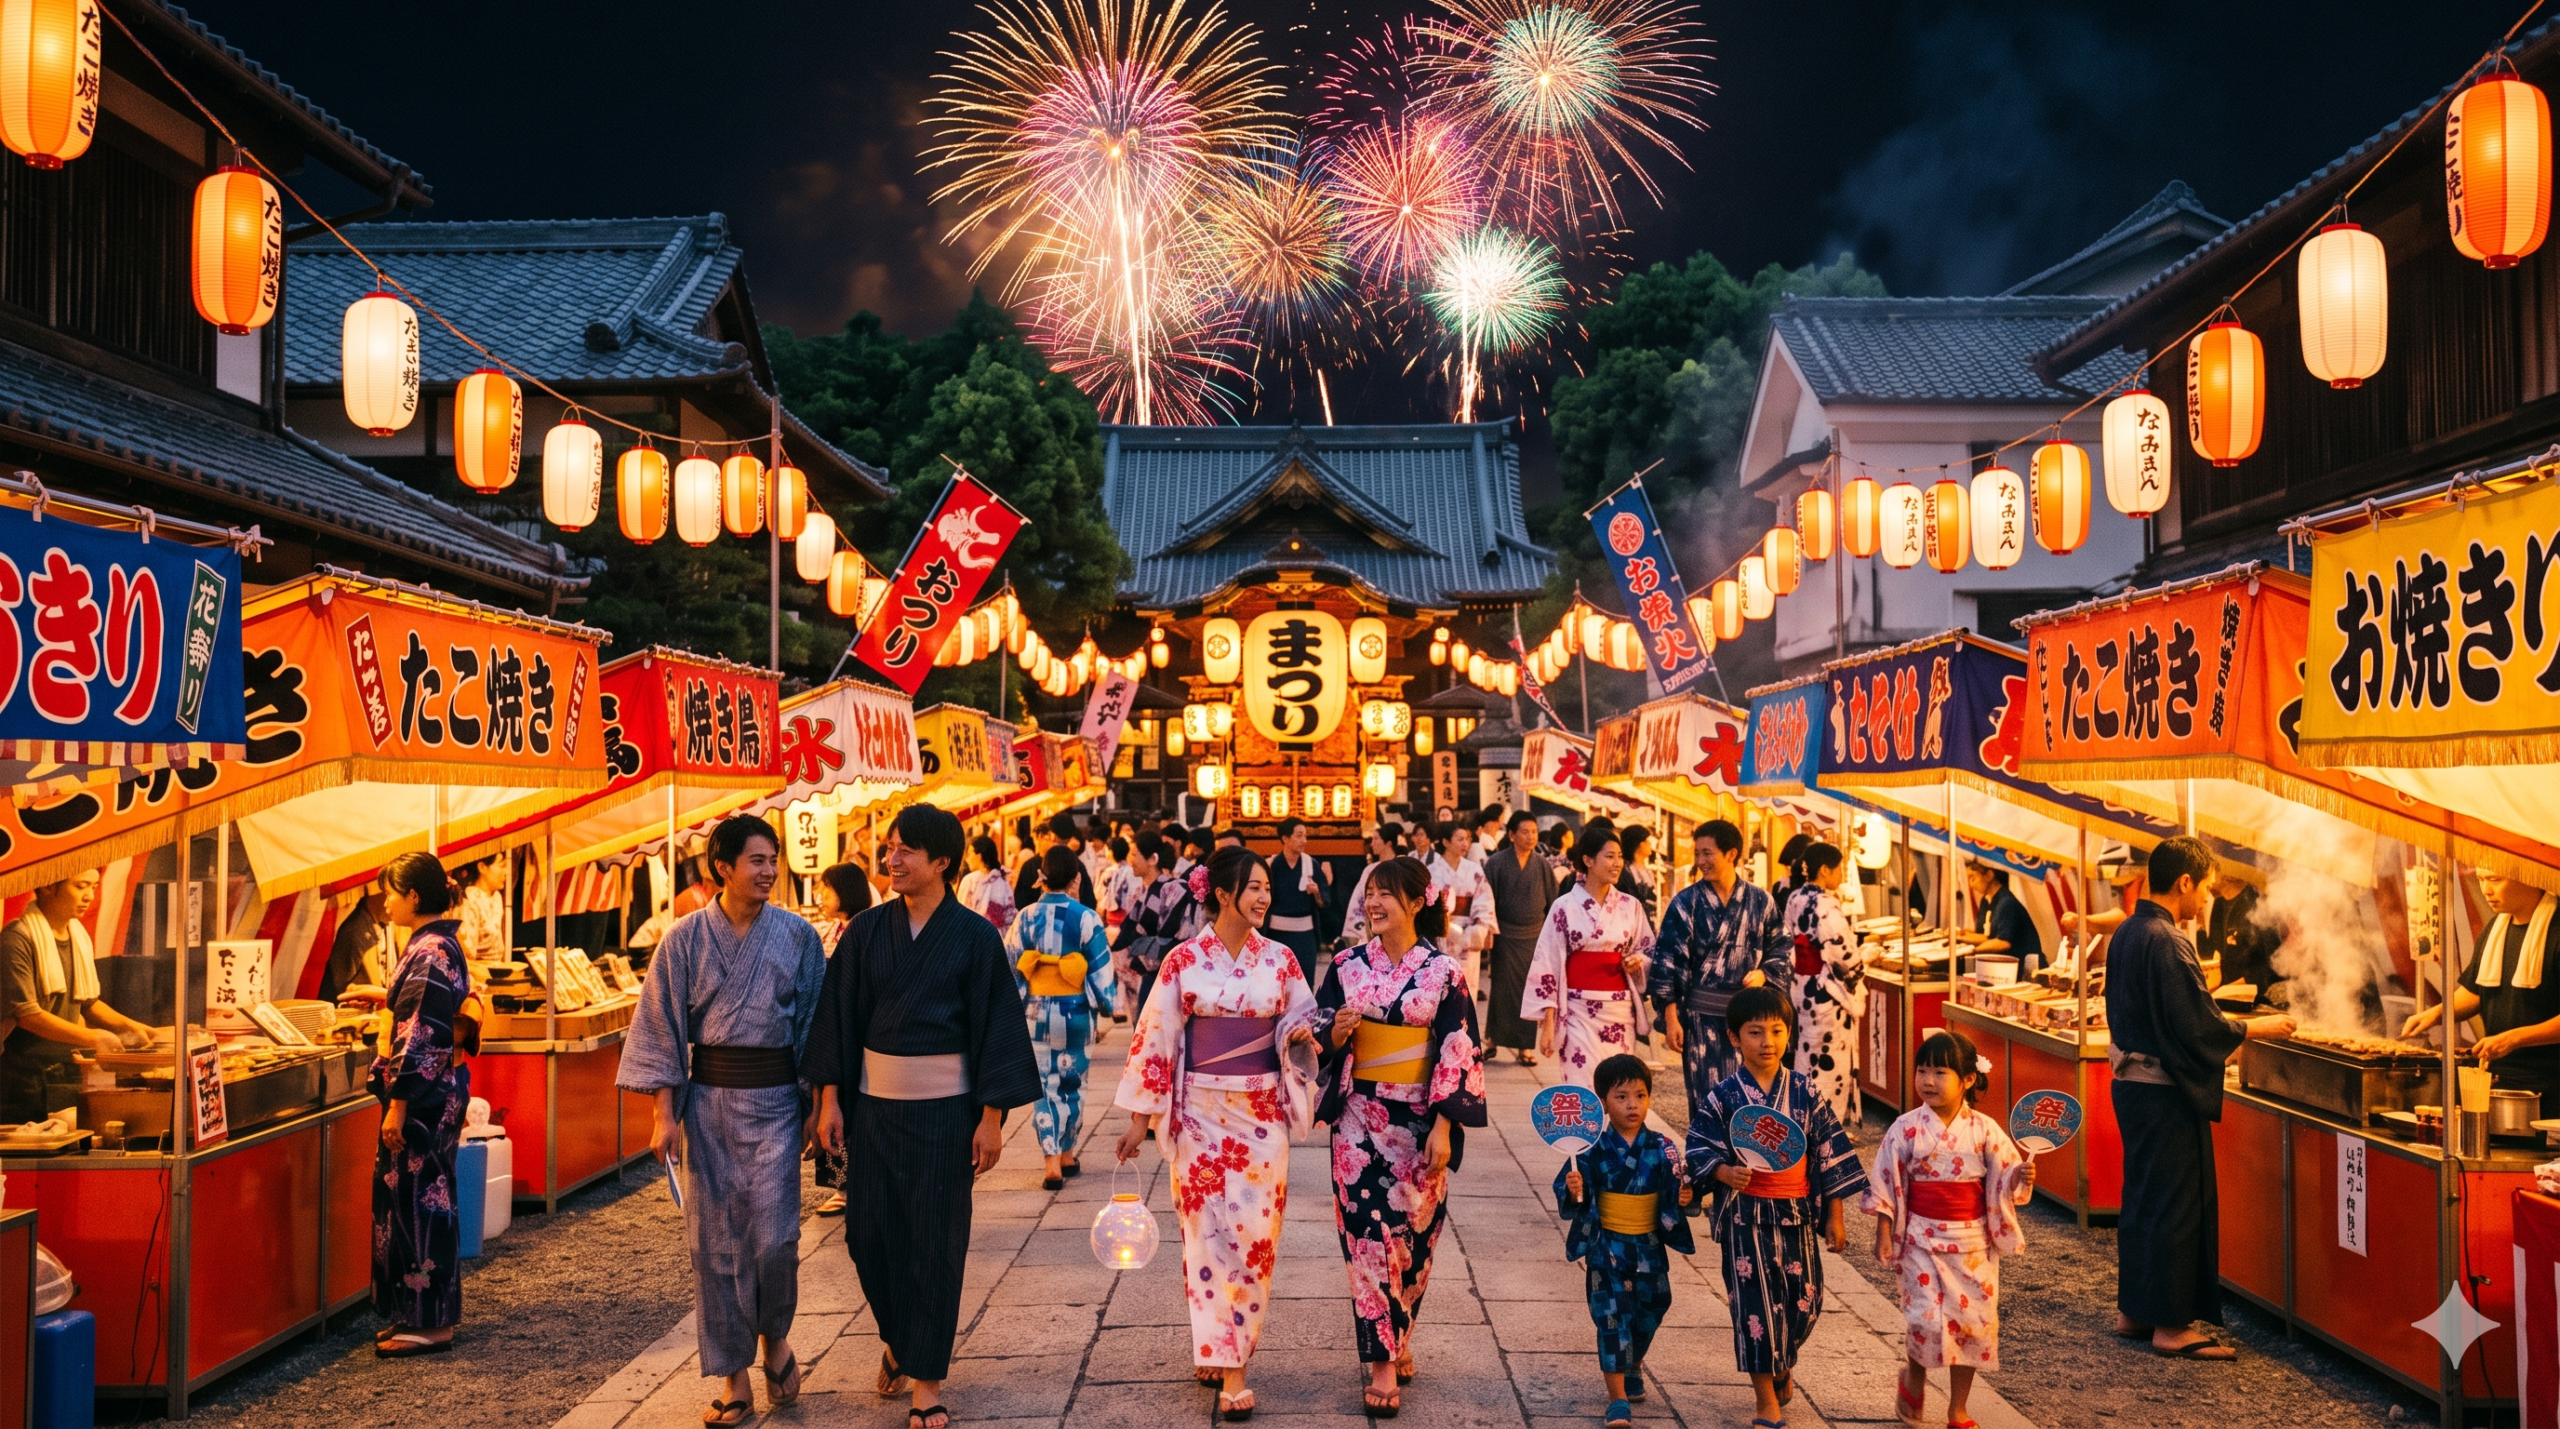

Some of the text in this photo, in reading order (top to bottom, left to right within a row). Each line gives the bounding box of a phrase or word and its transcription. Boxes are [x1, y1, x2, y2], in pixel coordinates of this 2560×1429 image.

[2137, 408, 2160, 491] なみまん
[883, 556, 960, 668] おつり
[400, 629, 556, 757] たこ焼き
[684, 677, 761, 768] 焼き鳥
[1267, 620, 1323, 737] まつり
[2060, 618, 2202, 743] たこ焼き
[1550, 1092, 1584, 1127] 祭
[1749, 1114, 1789, 1152] 祭
[2029, 1095, 2066, 1130] 祭
